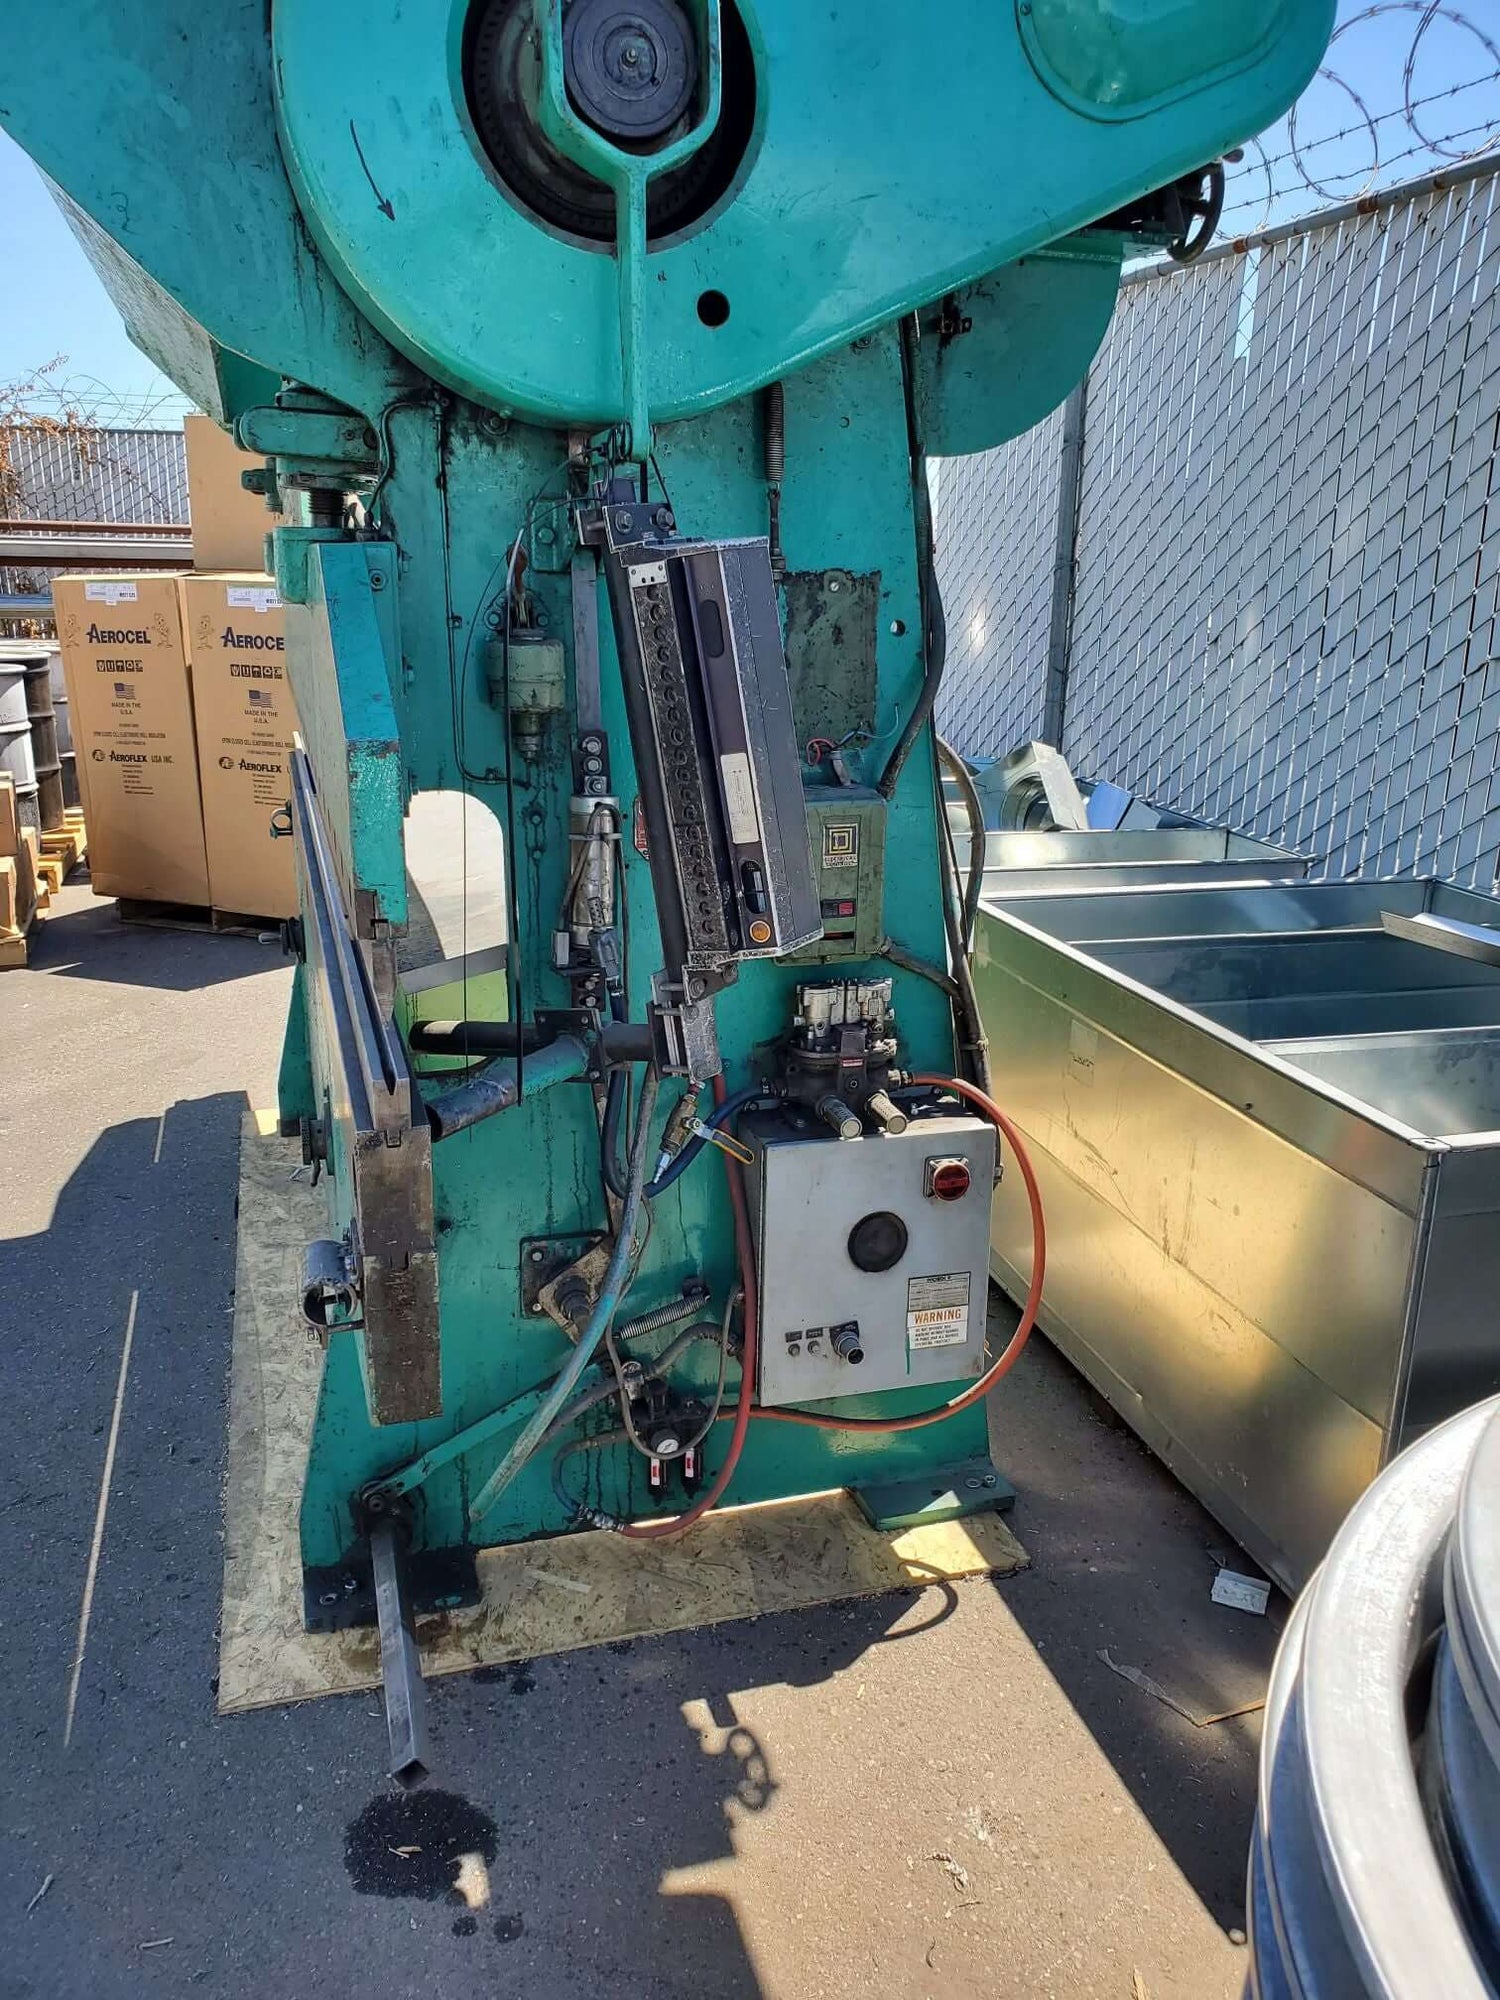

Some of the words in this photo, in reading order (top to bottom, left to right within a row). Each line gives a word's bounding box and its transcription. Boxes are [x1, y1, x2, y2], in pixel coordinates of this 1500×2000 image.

[86, 623, 152, 644] AEROCEL
[220, 626, 285, 651] AEROCE
[109, 750, 148, 763] AEROFLEX
[238, 758, 282, 773] AEROFLEX
[914, 1309, 961, 1325] WARNING
